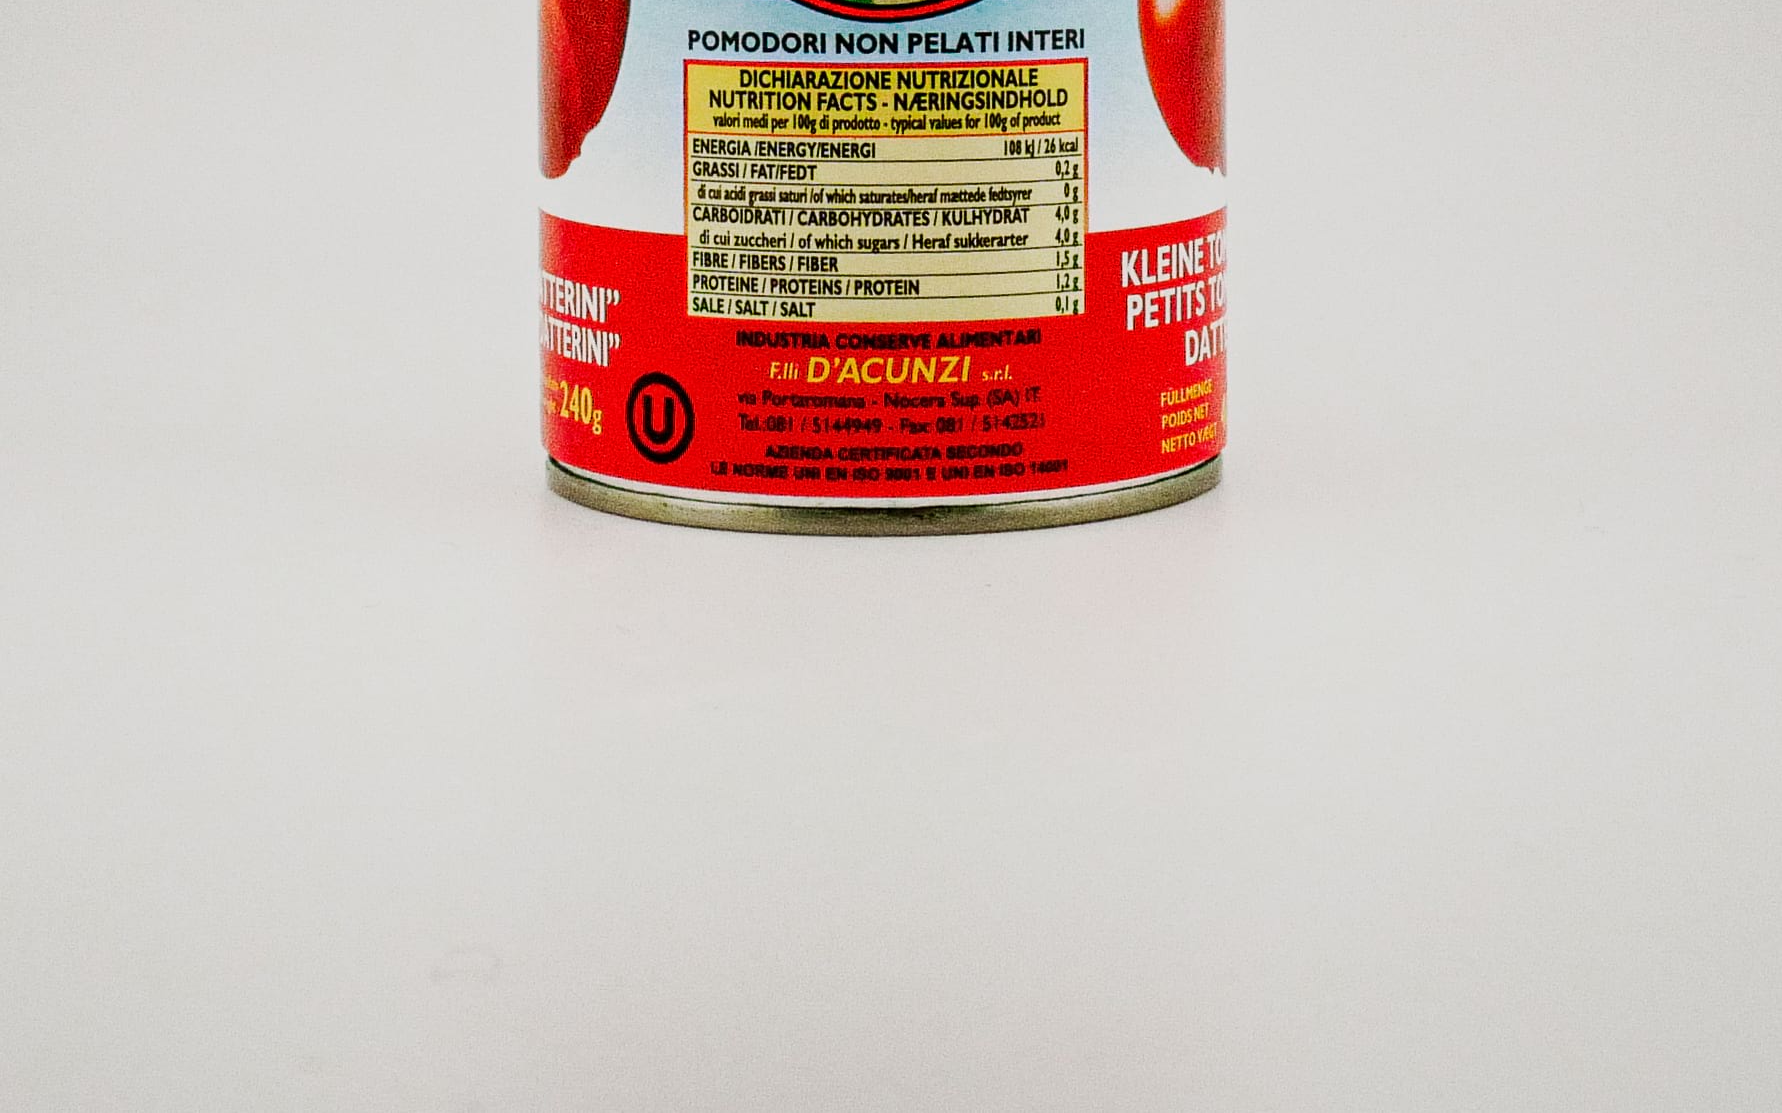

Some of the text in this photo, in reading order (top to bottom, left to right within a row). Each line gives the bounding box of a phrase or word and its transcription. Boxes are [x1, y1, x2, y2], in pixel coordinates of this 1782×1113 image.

[688, 28, 1085, 54] POMODORI NON PELATI INTERI
[740, 68, 1039, 90] DICHIARAZIONE NUTRIZIONALE
[709, 90, 812, 111] NUTRITION
[818, 92, 877, 112] FACTS
[894, 89, 1069, 112] NÆRINGSINDHOLD
[713, 112, 741, 128] valori
[743, 113, 769, 129] medi
[771, 117, 789, 133] per
[793, 114, 817, 134] 100g
[819, 115, 829, 130] di
[832, 115, 881, 134] prodotto
[891, 115, 926, 134] typical
[929, 114, 962, 130] values
[965, 113, 981, 129] for
[984, 113, 1007, 132] 100g
[1010, 112, 1021, 127] of
[1022, 111, 1061, 131] product
[693, 138, 750, 156] ENERGIA
[1003, 139, 1022, 156] 108
[1044, 138, 1056, 153] 26
[1059, 136, 1079, 153] kcal
[692, 161, 739, 178] GRASSI
[750, 163, 817, 180] FAT/FEDT
[1055, 159, 1070, 179] 0,2
[697, 186, 706, 199] di
[708, 186, 722, 200] cui
[724, 186, 746, 201] acidi
[748, 187, 776, 206] grassi
[778, 188, 807, 203] saturi
[826, 189, 856, 204] which
[940, 189, 986, 203] mættede
[988, 188, 1033, 206] fedtsyrer
[1064, 182, 1070, 198] 0
[693, 206, 786, 225] CARBOIDRATI
[797, 211, 930, 227] CARBOHYDRATES
[942, 208, 1030, 226] KULHYDRAT
[699, 230, 710, 245] di
[713, 231, 730, 246] cui
[734, 232, 787, 248] zuccheri
[798, 234, 813, 249] of
[814, 234, 853, 249] which
[857, 237, 900, 253] sugars
[912, 233, 951, 249] Heraf
[953, 232, 1029, 248] sukkerarter
[693, 252, 728, 269] FIBRE
[739, 255, 786, 272] FIBERS
[798, 256, 838, 272] FIBER
[1121, 237, 1205, 288] KLEINE
[692, 275, 759, 293] PROTEINE
[771, 278, 843, 295] PROTEINS
[855, 279, 920, 296] PROTEIN
[692, 297, 724, 314] SALE
[735, 298, 768, 316] SALT
[780, 300, 816, 317] SALT
[1126, 280, 1206, 331] PETITS
[736, 328, 1042, 350] INDUSTRIA CONSERVE ALIMENTARI
[982, 364, 1013, 381] s.r.l.
[560, 380, 603, 435] 240g
[884, 392, 945, 408] Nocera
[986, 388, 1020, 408] (SA)
[1162, 408, 1193, 430] POIDS
[1194, 401, 1210, 422] NET
[765, 441, 1023, 461] AZIENDA CERTIFICATA SECONDO
[1161, 431, 1196, 454] NETTO
[733, 463, 789, 479] NORME
[793, 466, 821, 480] UNI
[825, 467, 848, 481] EN
[852, 467, 881, 481] ISO
[941, 465, 970, 480] UNI
[973, 464, 995, 479] EN
[999, 462, 1025, 477] ISO
